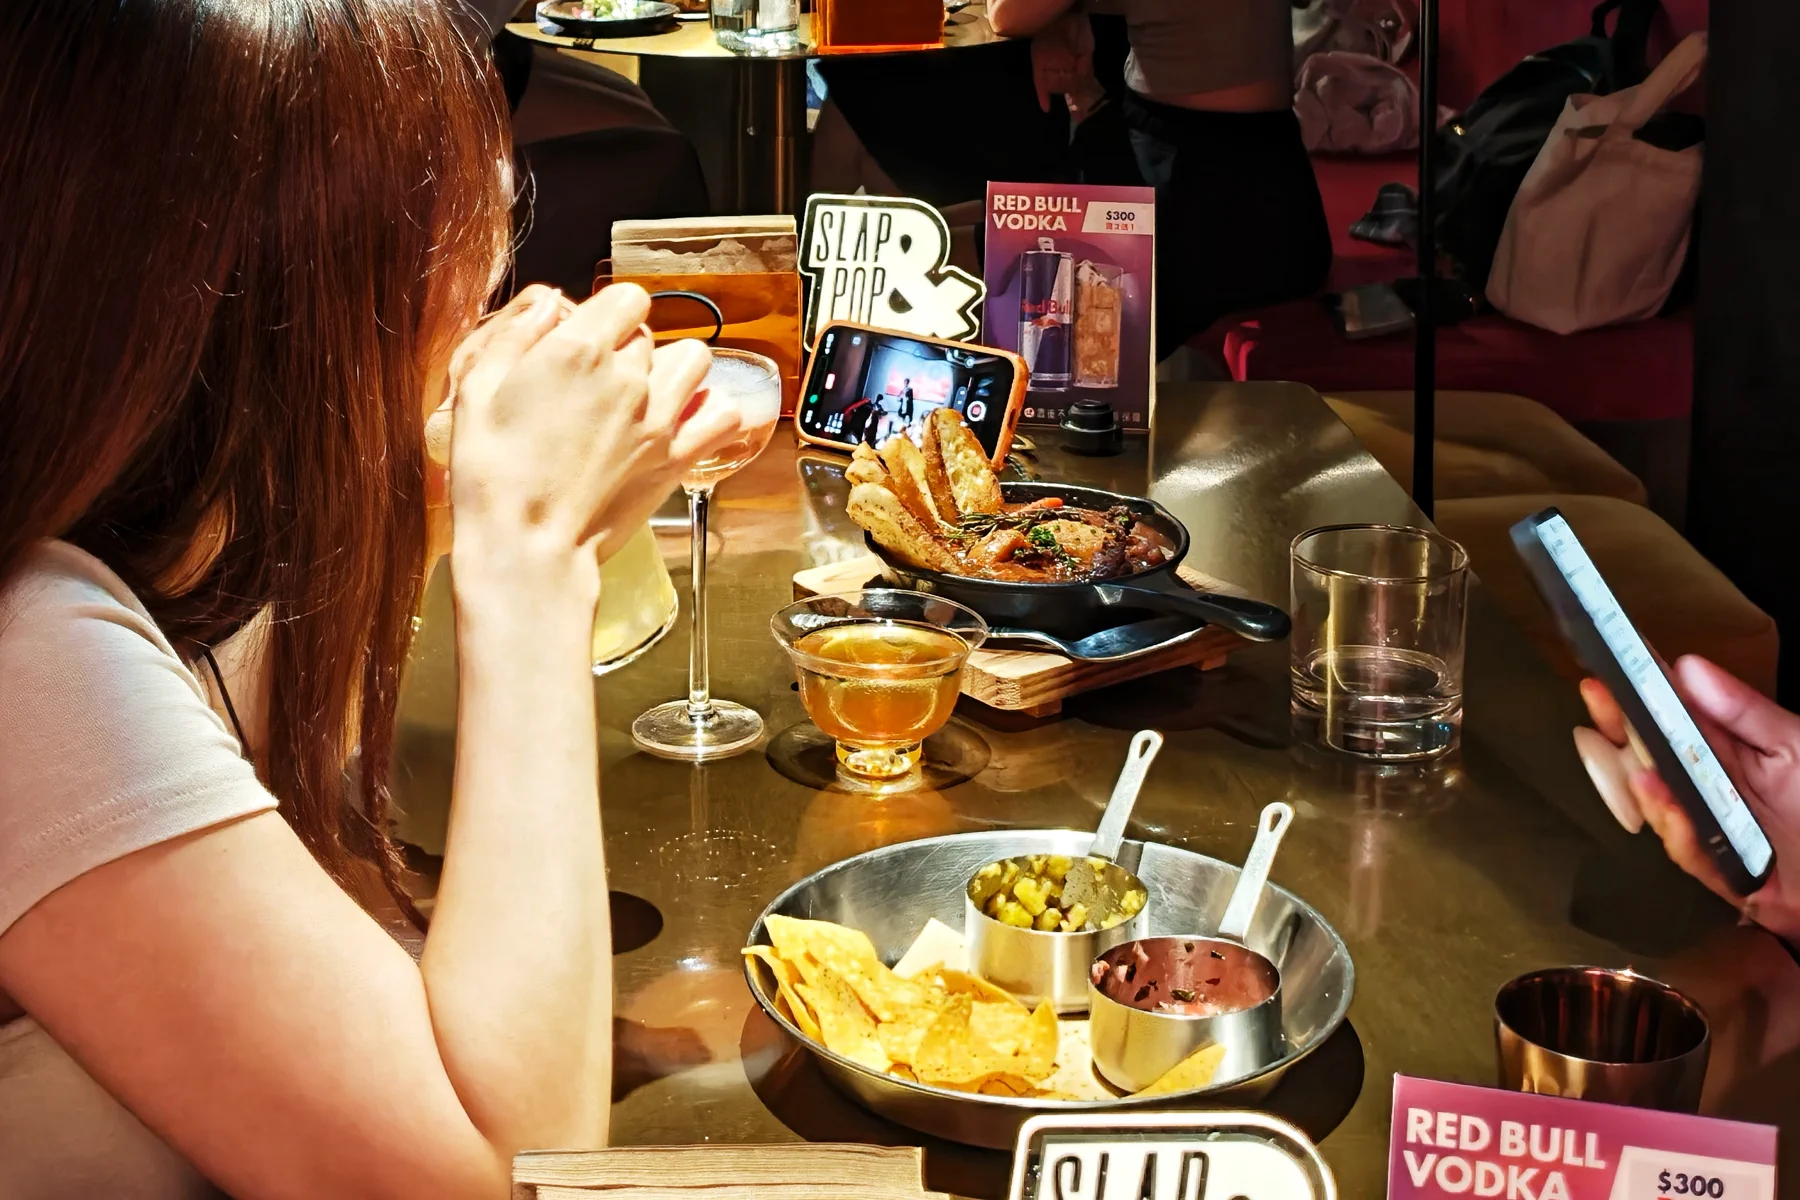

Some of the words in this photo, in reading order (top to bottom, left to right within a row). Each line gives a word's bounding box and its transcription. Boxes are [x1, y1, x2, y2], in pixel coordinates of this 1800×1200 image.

[993, 194, 1031, 212] RED
[1034, 196, 1082, 213] BULL
[1105, 210, 1136, 221] $300
[816, 211, 892, 263] SLAP
[992, 213, 1067, 232] VODKA
[1406, 1107, 1491, 1151] RED
[1500, 1121, 1606, 1169] BULL
[1404, 1150, 1572, 1200] VODKA
[1657, 1167, 1724, 1199] $300
